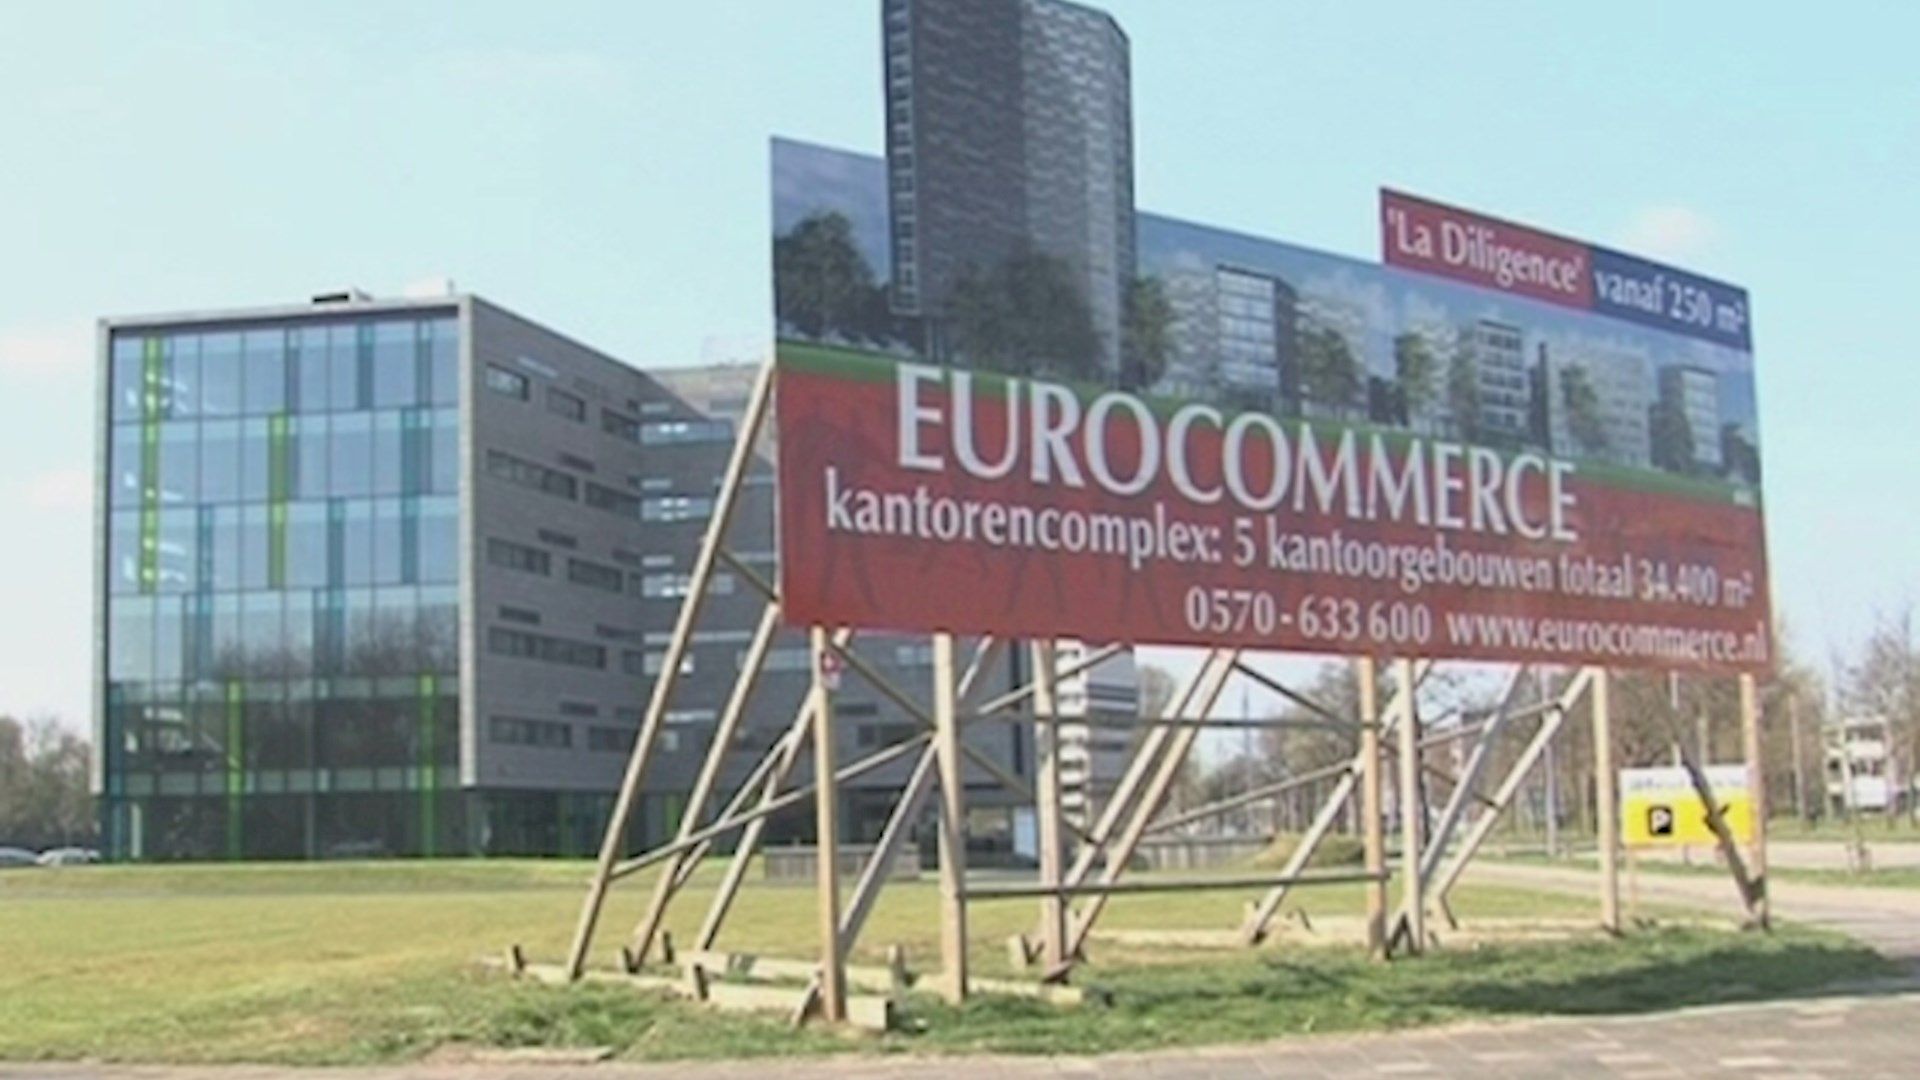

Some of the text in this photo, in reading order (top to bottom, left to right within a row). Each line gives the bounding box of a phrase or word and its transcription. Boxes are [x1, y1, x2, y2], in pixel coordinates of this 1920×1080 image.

[1594, 271, 1665, 315] vanaf
[1668, 281, 1713, 328] 250
[896, 363, 1578, 543] EUROCOMMERCE
[825, 467, 1222, 569] kantorencomplex:
[1232, 517, 1256, 567] 5
[1266, 515, 1554, 593] kantoorgebouwen
[1559, 553, 1634, 599] totaal
[1637, 558, 1719, 607] 34.400
[1445, 610, 1768, 662] www.eurocommerce.nl
